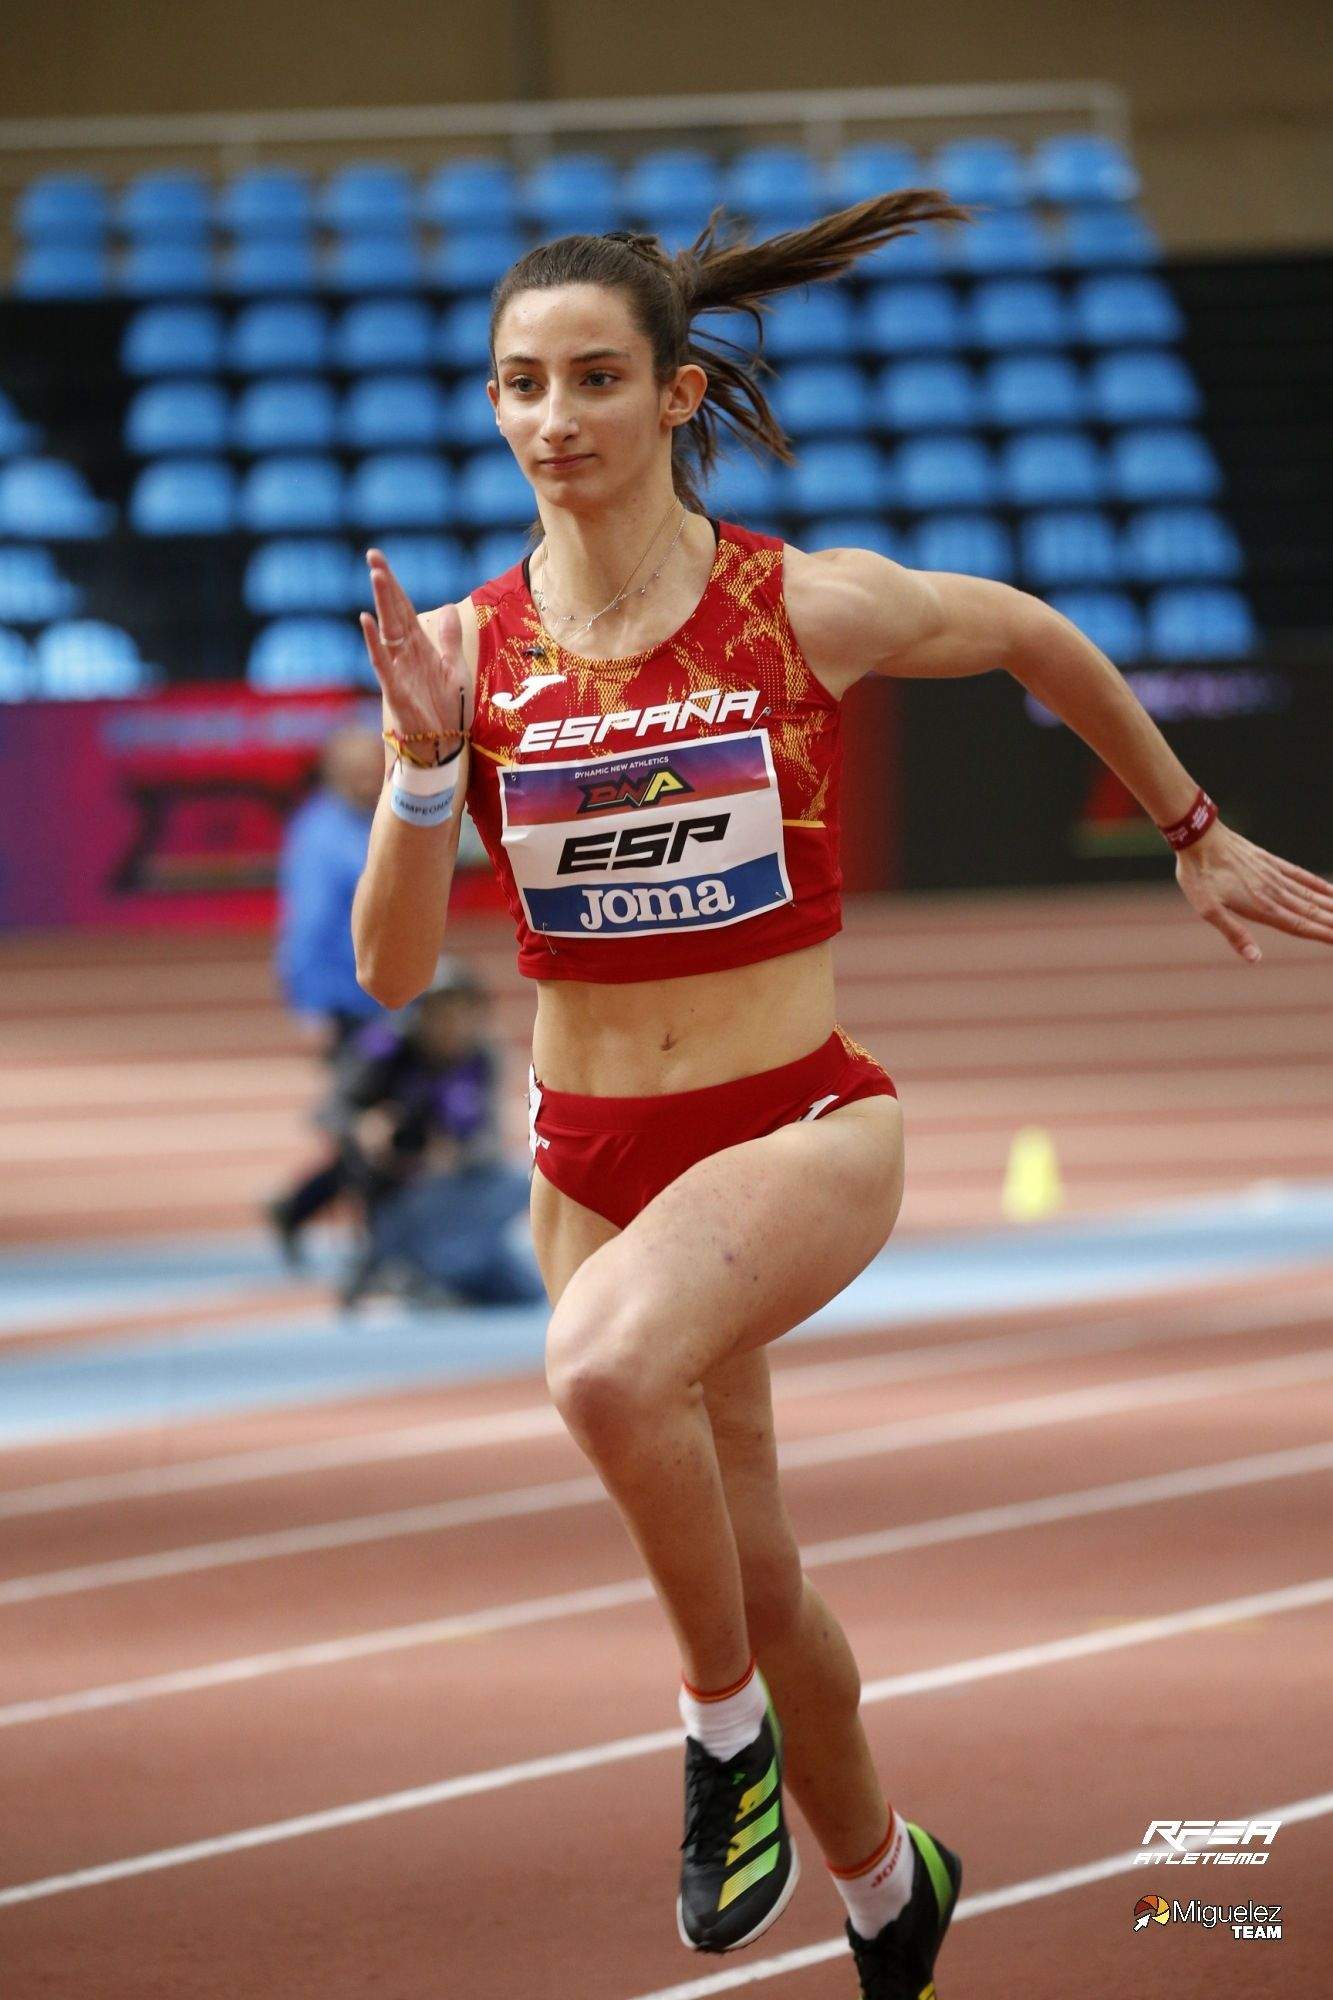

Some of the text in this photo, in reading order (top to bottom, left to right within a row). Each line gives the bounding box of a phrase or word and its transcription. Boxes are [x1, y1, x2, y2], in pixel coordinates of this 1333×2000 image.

[518, 689, 761, 753] ESPAÑA
[574, 755, 669, 779] DYNAMIC NEW ATHLETICS
[556, 812, 732, 876] ESP
[579, 878, 736, 931] Joma
